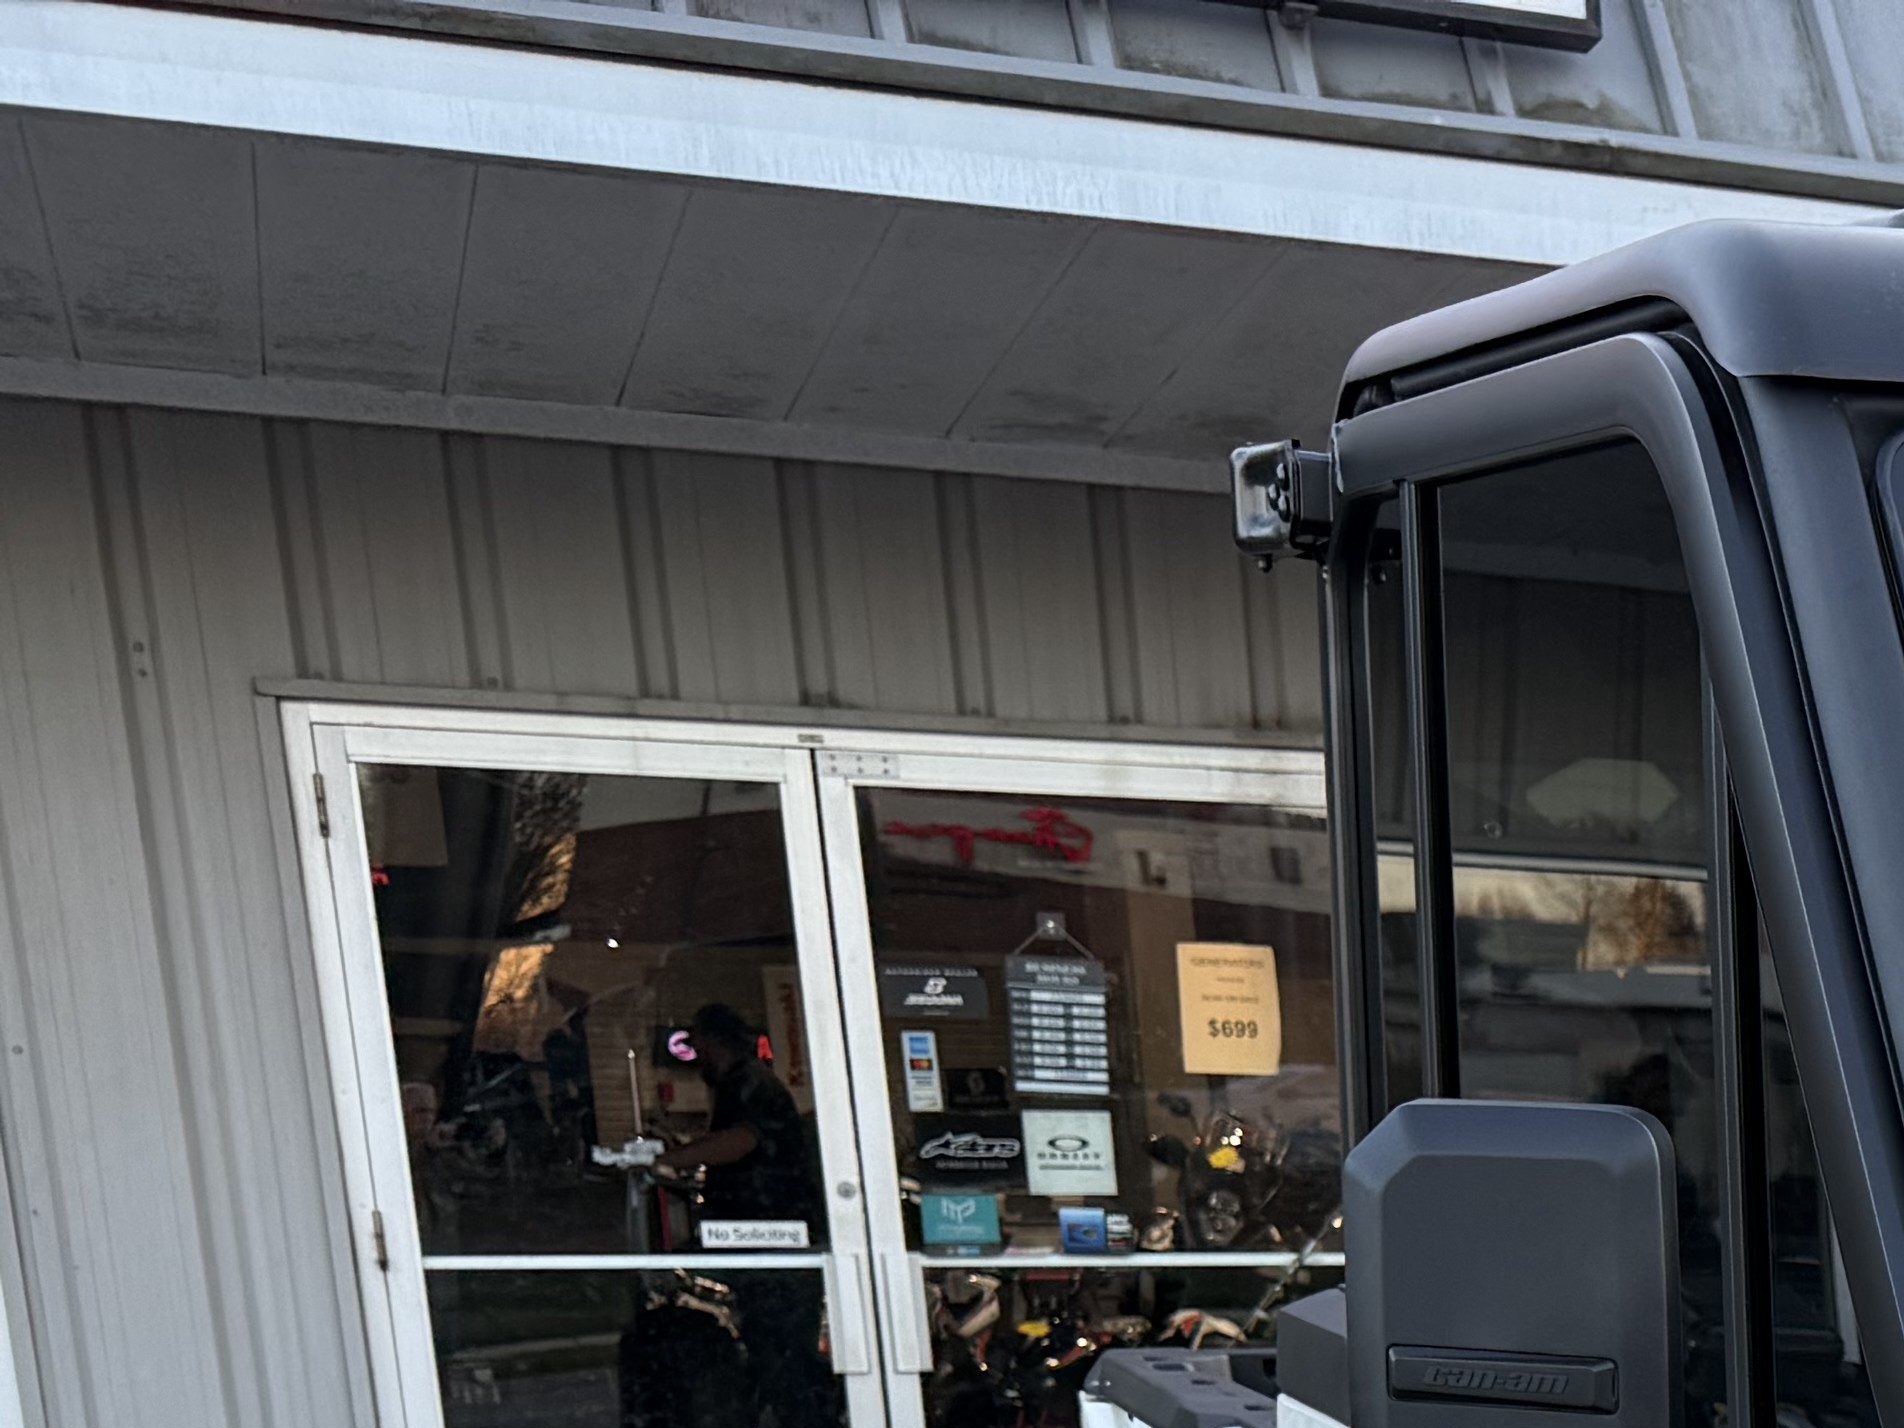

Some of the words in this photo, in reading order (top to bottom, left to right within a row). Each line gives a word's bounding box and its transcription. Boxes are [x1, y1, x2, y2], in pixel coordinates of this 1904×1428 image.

[1207, 1018, 1259, 1039] $699
[707, 1228, 729, 1242] No
[1423, 1364, 1570, 1394] can-am
